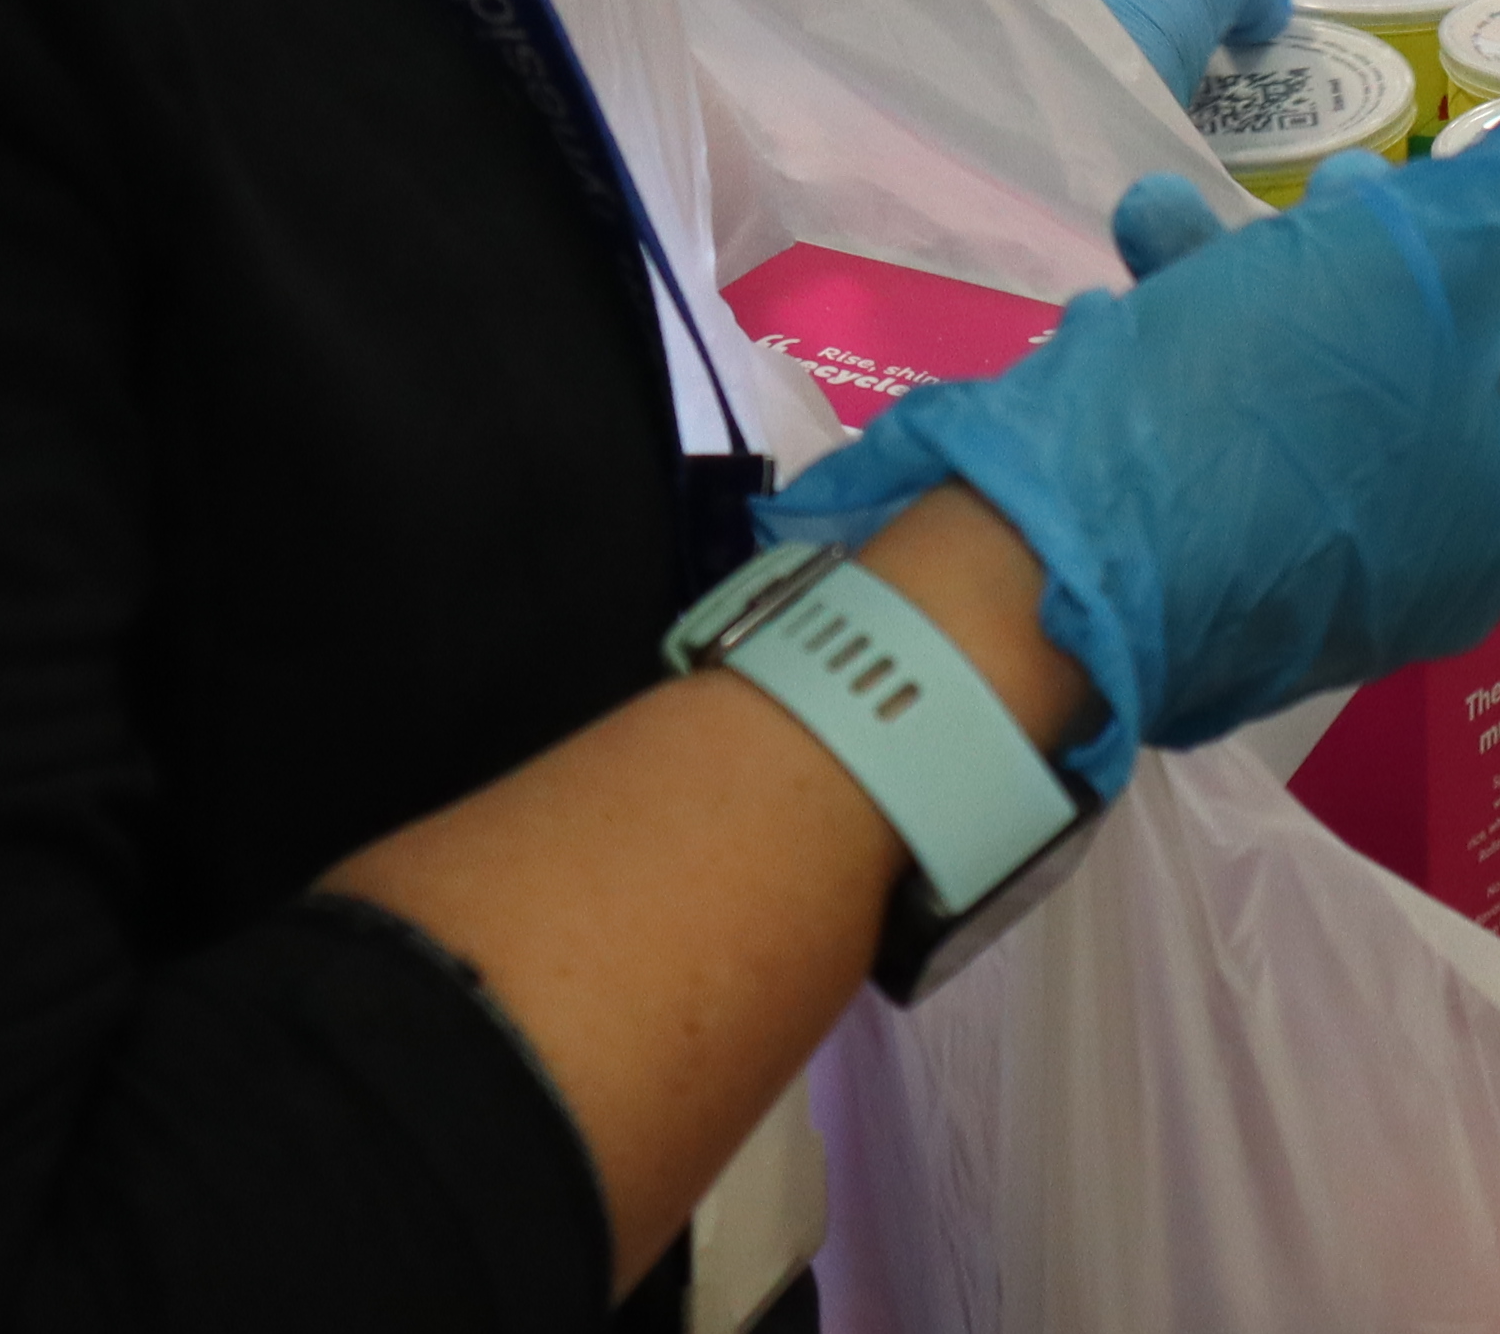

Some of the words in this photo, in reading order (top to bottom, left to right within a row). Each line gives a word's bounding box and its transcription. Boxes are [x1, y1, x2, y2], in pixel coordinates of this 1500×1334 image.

[795, 358, 911, 398] ecycle
[817, 347, 877, 373] Rise,
[883, 364, 941, 385] shin
